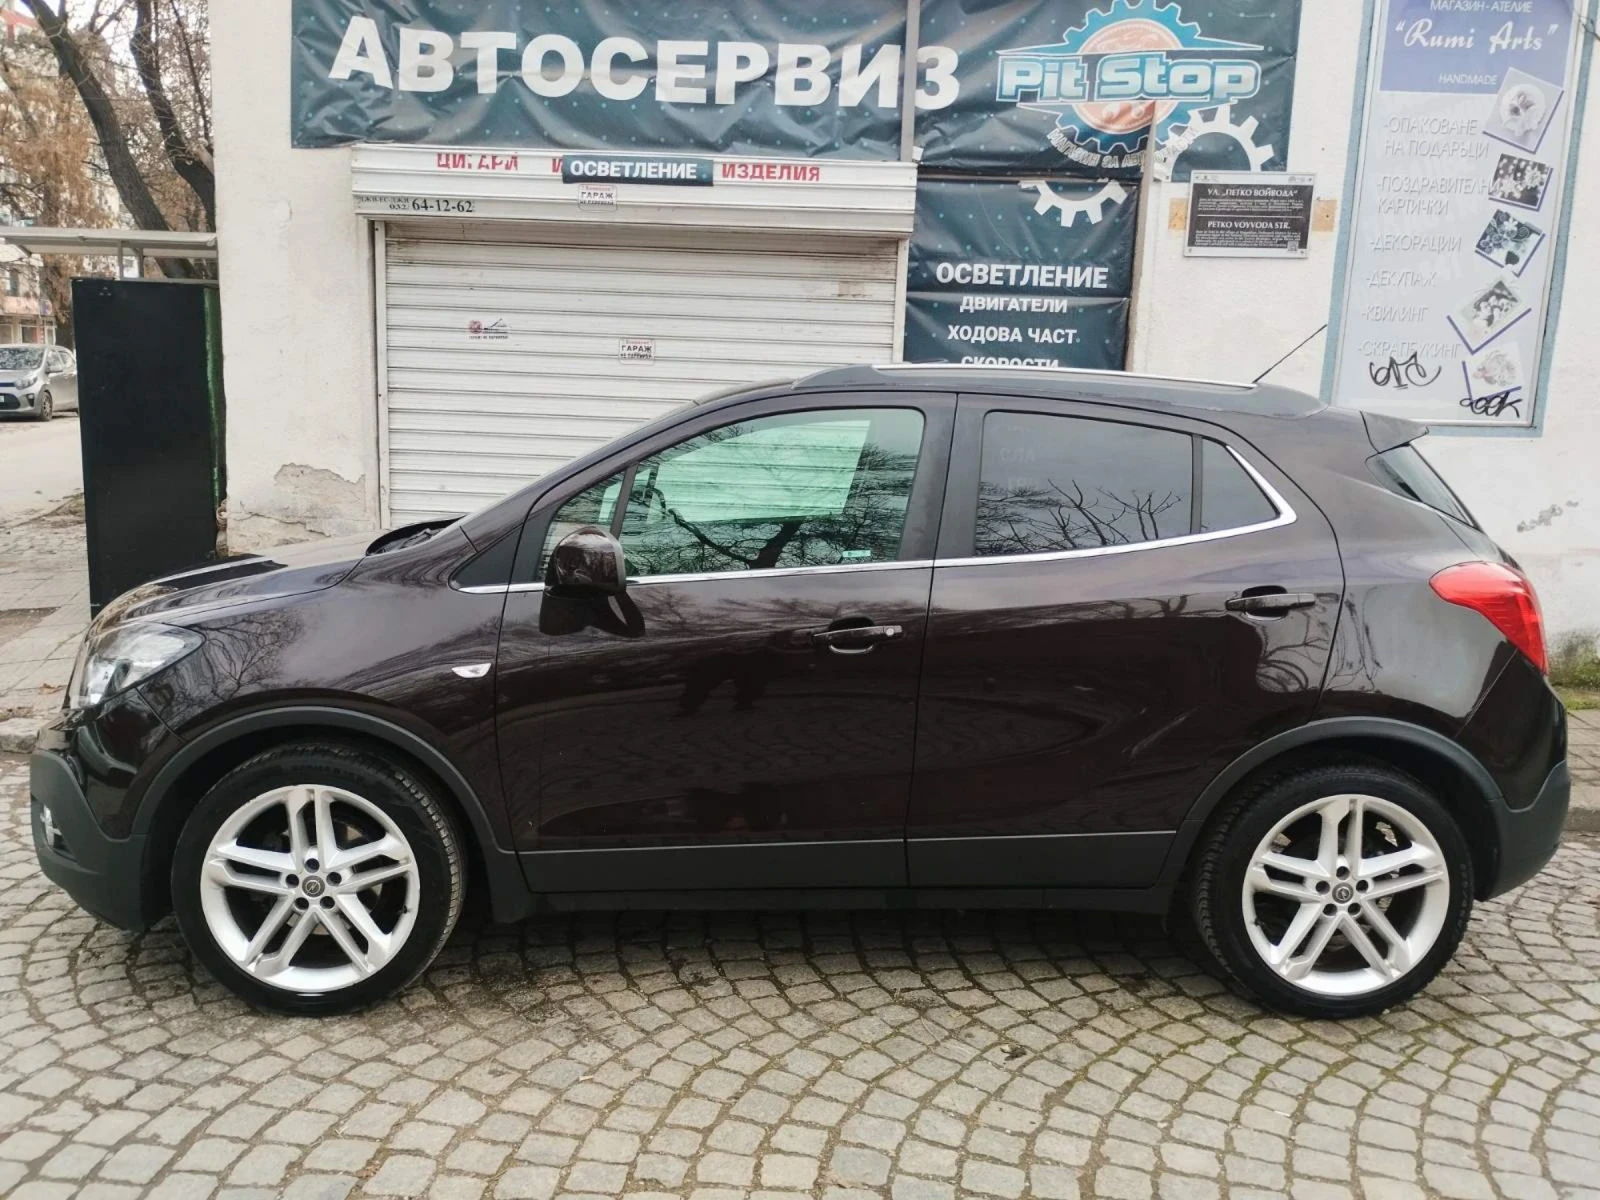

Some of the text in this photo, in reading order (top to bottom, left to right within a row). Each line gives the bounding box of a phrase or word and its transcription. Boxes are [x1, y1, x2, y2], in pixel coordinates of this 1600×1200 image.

[328, 15, 961, 111] АВТОСЕРВИЗ
[1000, 56, 1259, 101] Pit Stop
[1438, 73, 1499, 86] HANDMADE
[1385, 139, 1404, 156] НА
[569, 160, 698, 181] ОСВЕТЛЕНИЕ
[721, 163, 821, 182] ИЗДЕЛИЯ
[411, 198, 474, 213] 64-12-62
[1207, 220, 1291, 230] PETKO VOYVODA STR.
[935, 261, 1109, 289] ОСВЕТЛЕНИЕ
[959, 295, 1068, 313] ДВИГАТЕЛИ
[947, 325, 1023, 344] ХОДОВА
